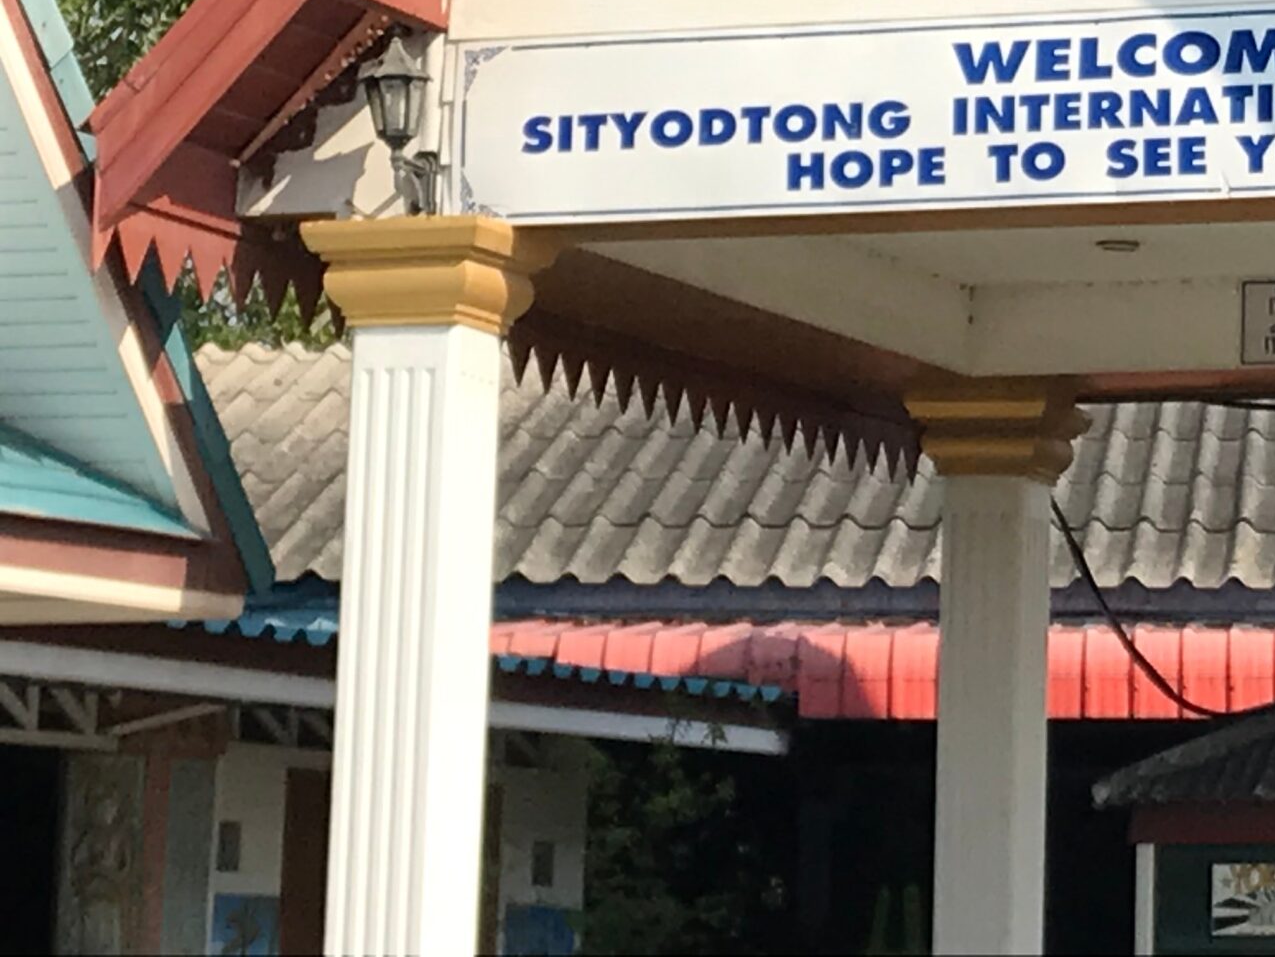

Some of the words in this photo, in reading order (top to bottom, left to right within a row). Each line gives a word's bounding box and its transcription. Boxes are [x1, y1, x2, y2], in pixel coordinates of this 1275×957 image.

[522, 100, 911, 153] SITYODTONG
[786, 146, 946, 191] HOPE
[988, 141, 1067, 183] TO
[1105, 135, 1208, 178] SEE
